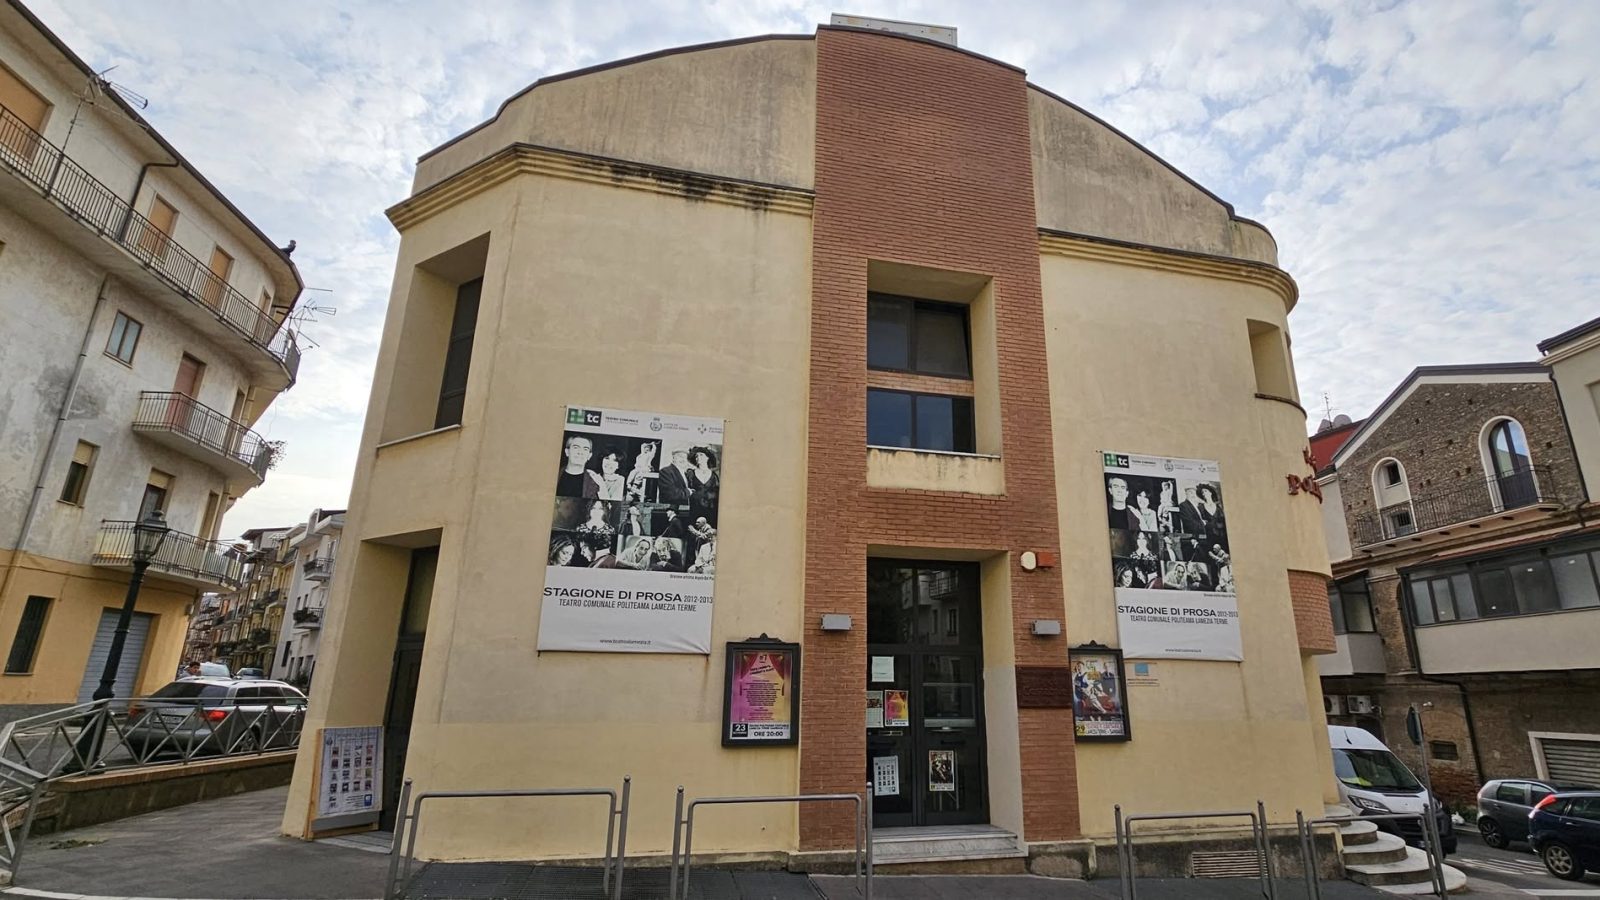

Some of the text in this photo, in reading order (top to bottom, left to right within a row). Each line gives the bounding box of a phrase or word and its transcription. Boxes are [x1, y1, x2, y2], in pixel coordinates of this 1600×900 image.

[586, 412, 599, 424] tc
[543, 587, 713, 604] STAGIONE DI PROSA 2012-2013
[559, 598, 697, 612] TEATRO COMUNALE POLITEAMA LAMEZIA TERME
[1117, 605, 1168, 615] STAGIONE
[1170, 607, 1181, 616] DI
[1183, 608, 1217, 617] PROSA
[735, 724, 746, 732] 23
